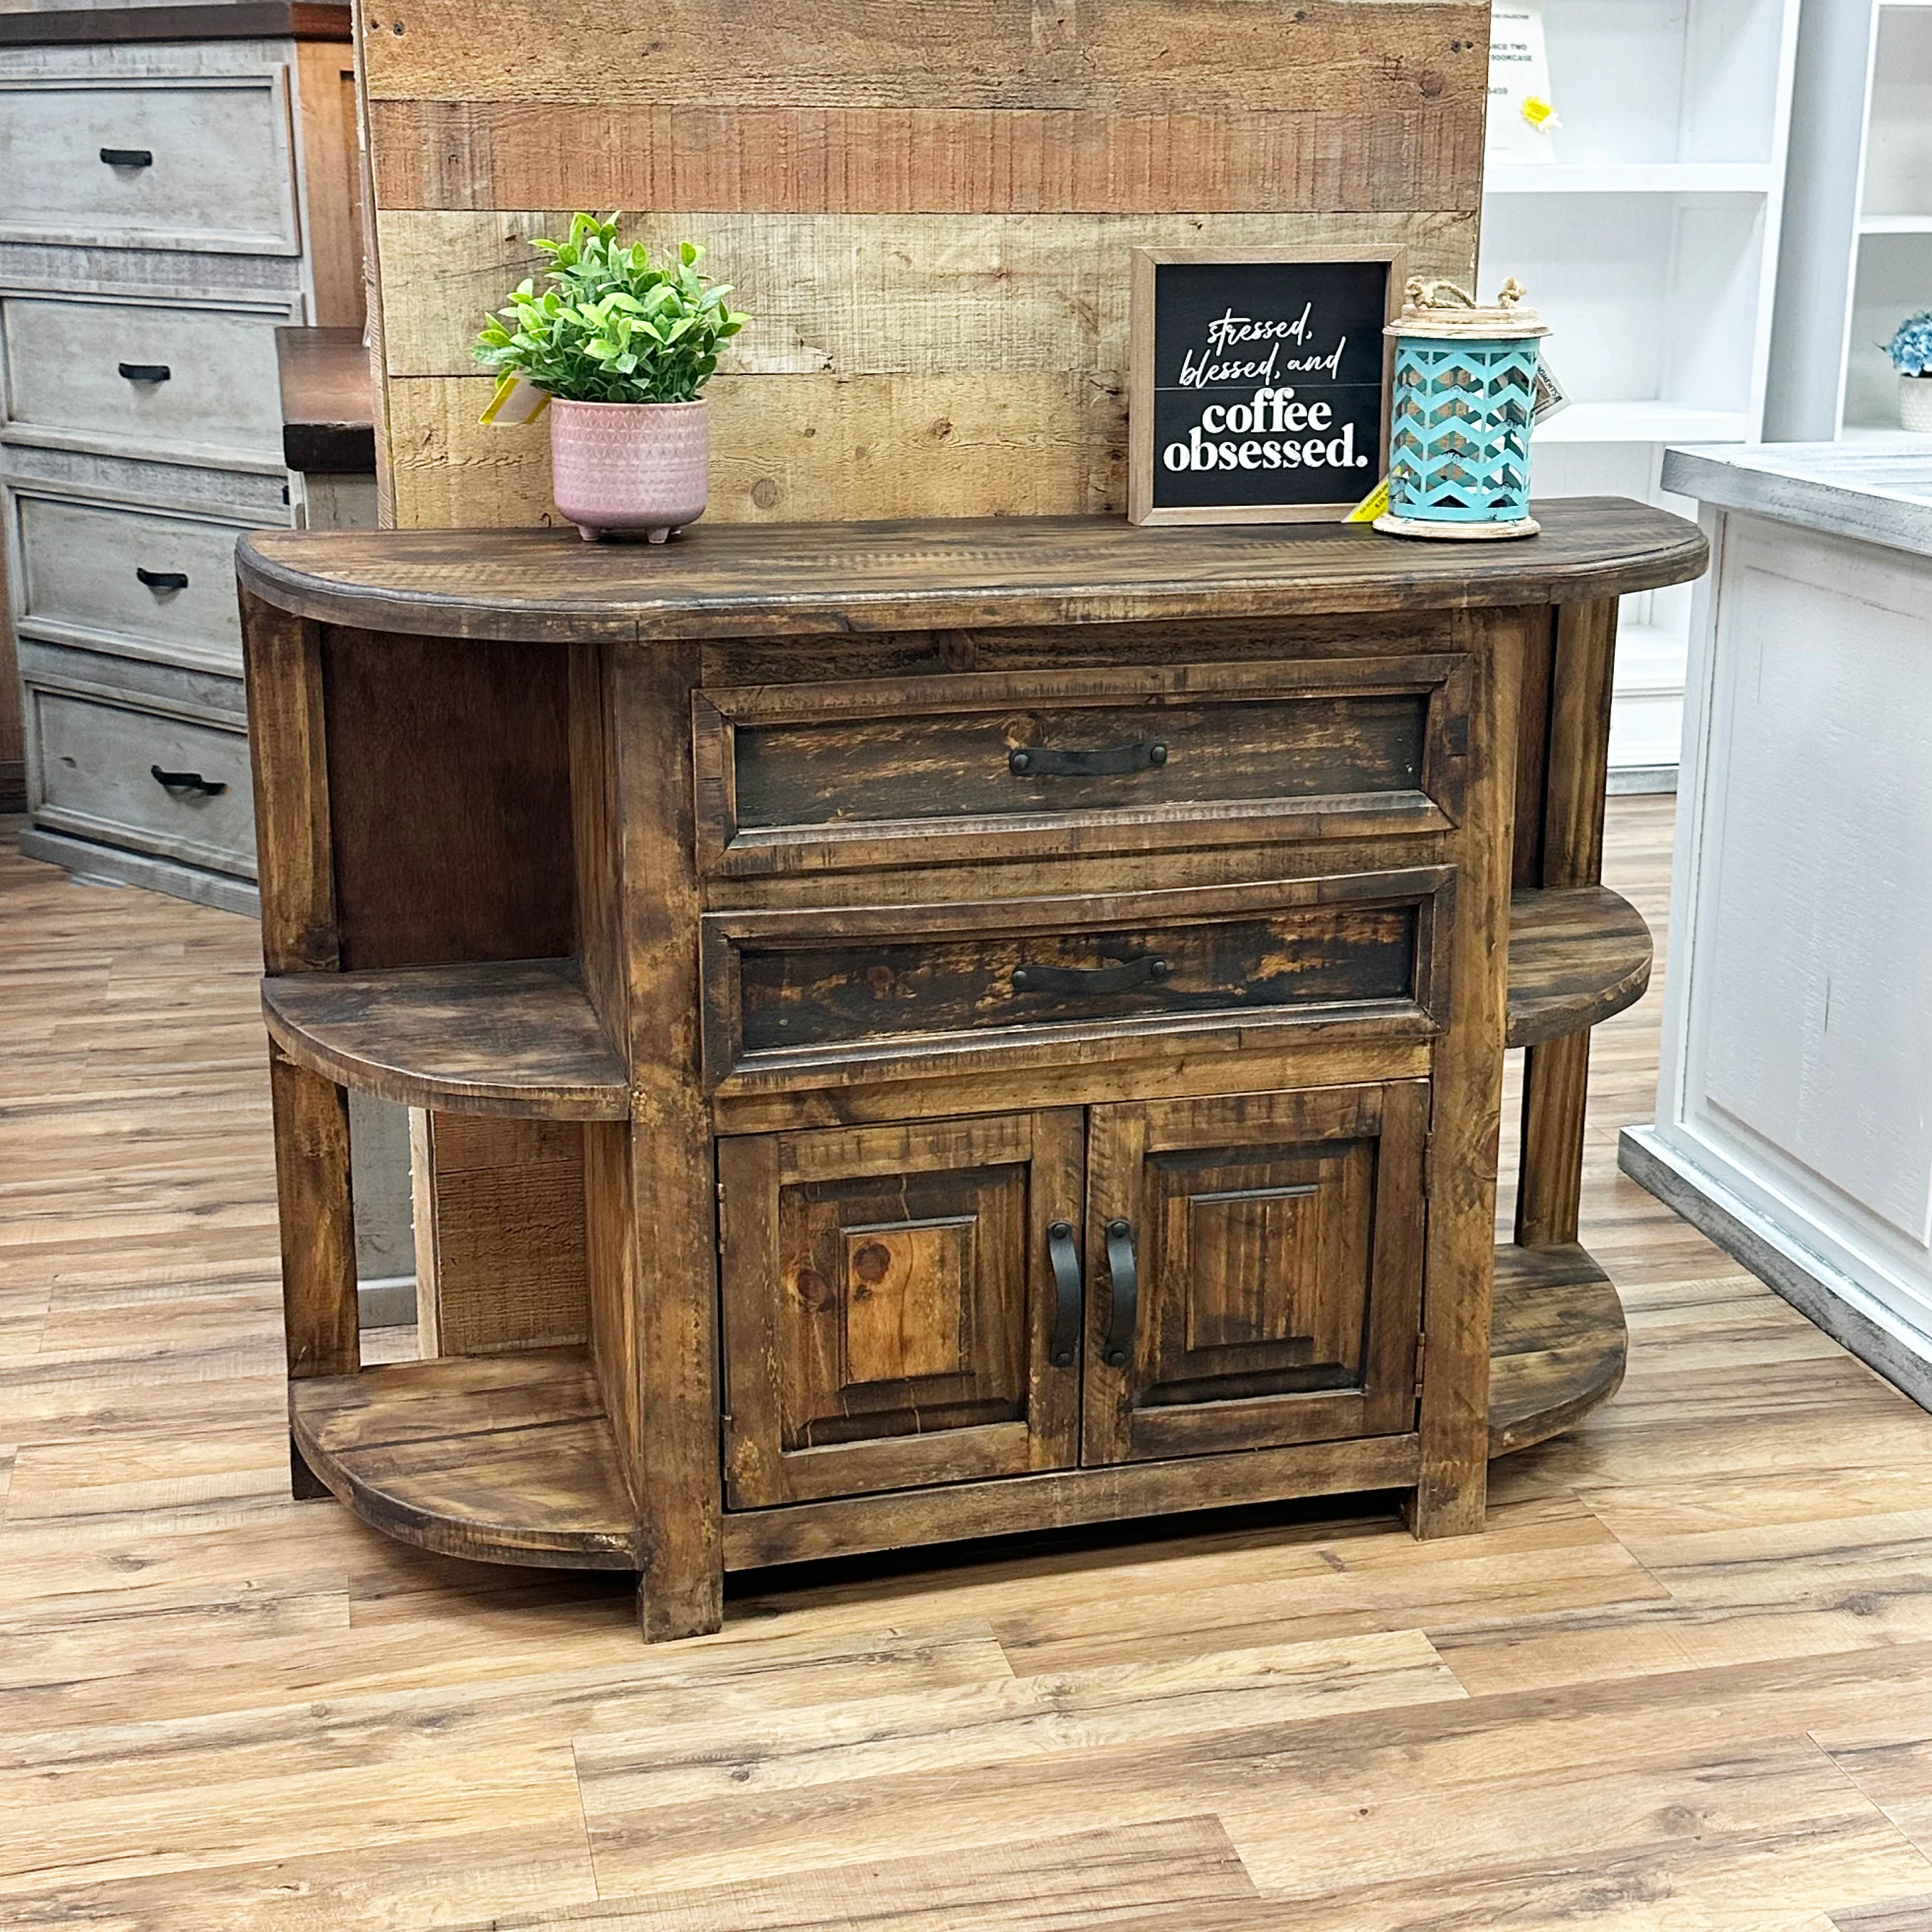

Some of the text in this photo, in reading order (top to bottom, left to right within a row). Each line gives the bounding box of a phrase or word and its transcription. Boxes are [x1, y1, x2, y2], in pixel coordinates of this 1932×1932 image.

[1207, 302, 1313, 356] stressed,
[1178, 336, 1346, 389] blessed, and
[1202, 387, 1332, 433] coffee
[1163, 423, 1368, 471] obsessed.
